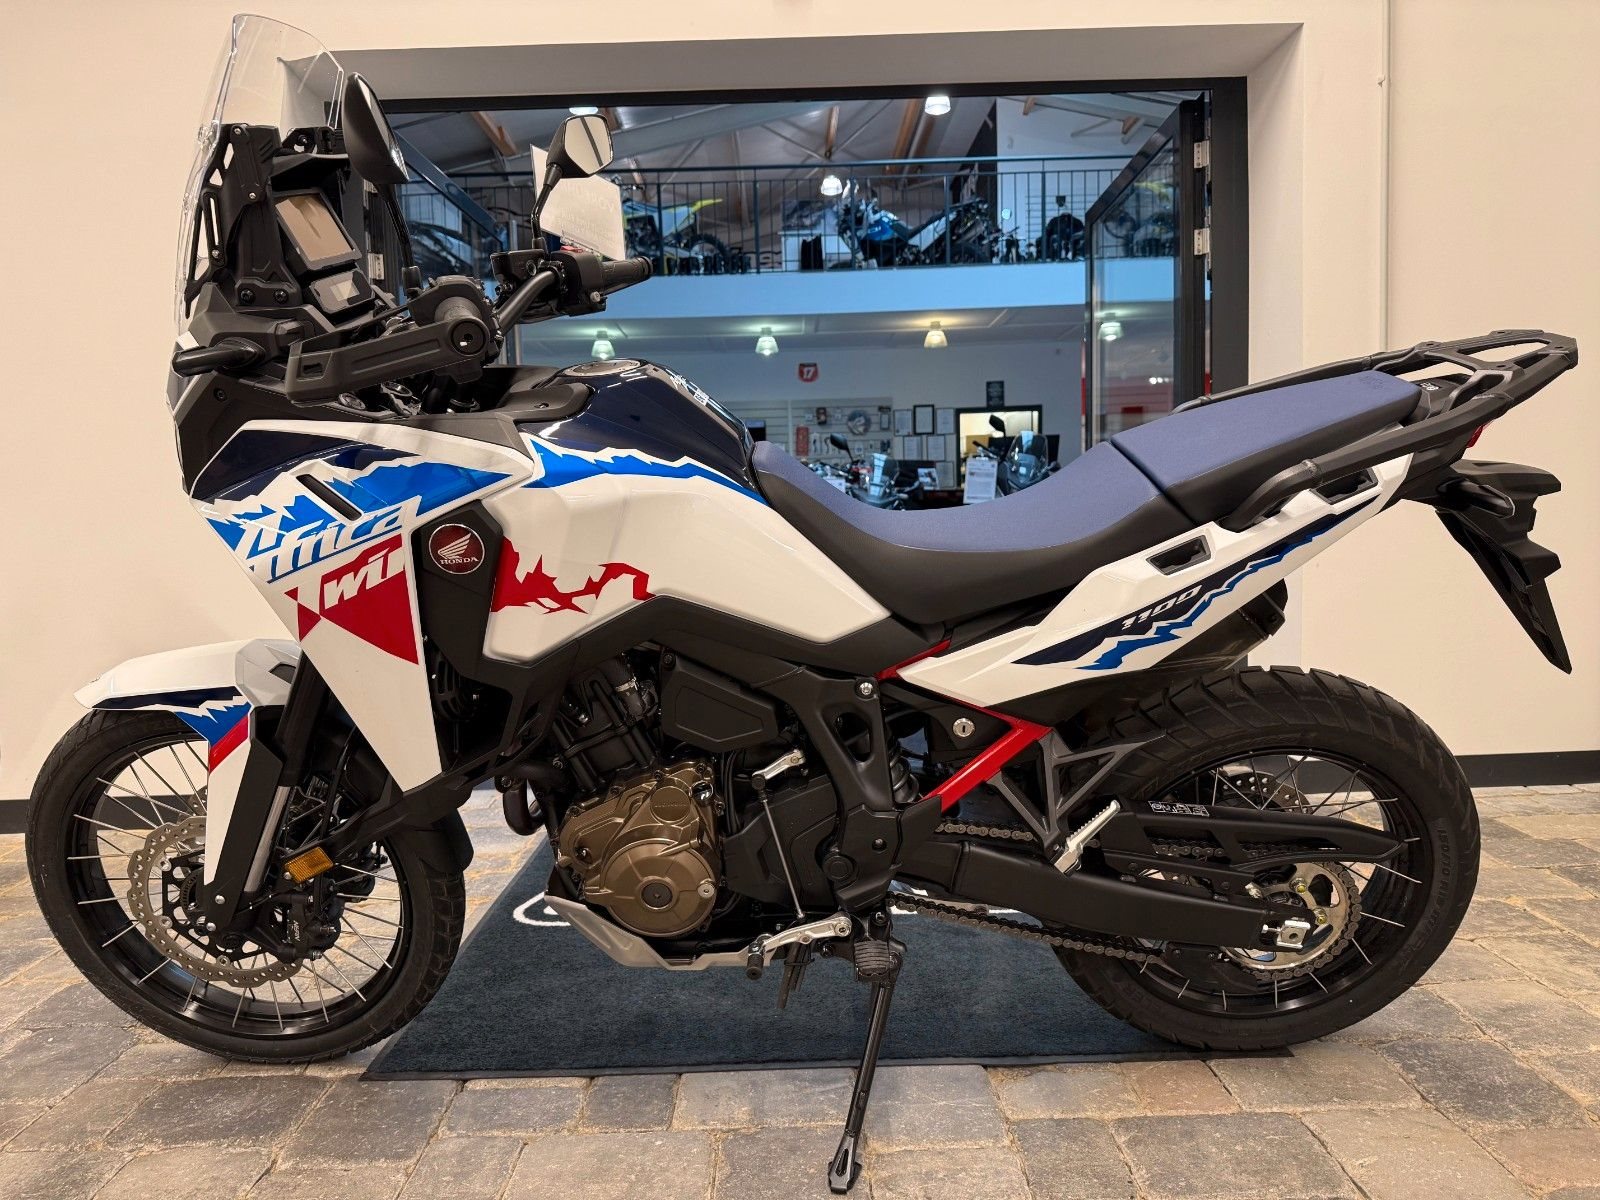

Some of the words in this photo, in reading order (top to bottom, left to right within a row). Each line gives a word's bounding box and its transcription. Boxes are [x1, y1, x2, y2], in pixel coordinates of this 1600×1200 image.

[803, 366, 816, 380] 17
[232, 503, 406, 582] Africa
[440, 557, 479, 565] HONDA
[1121, 585, 1202, 630] 1100
